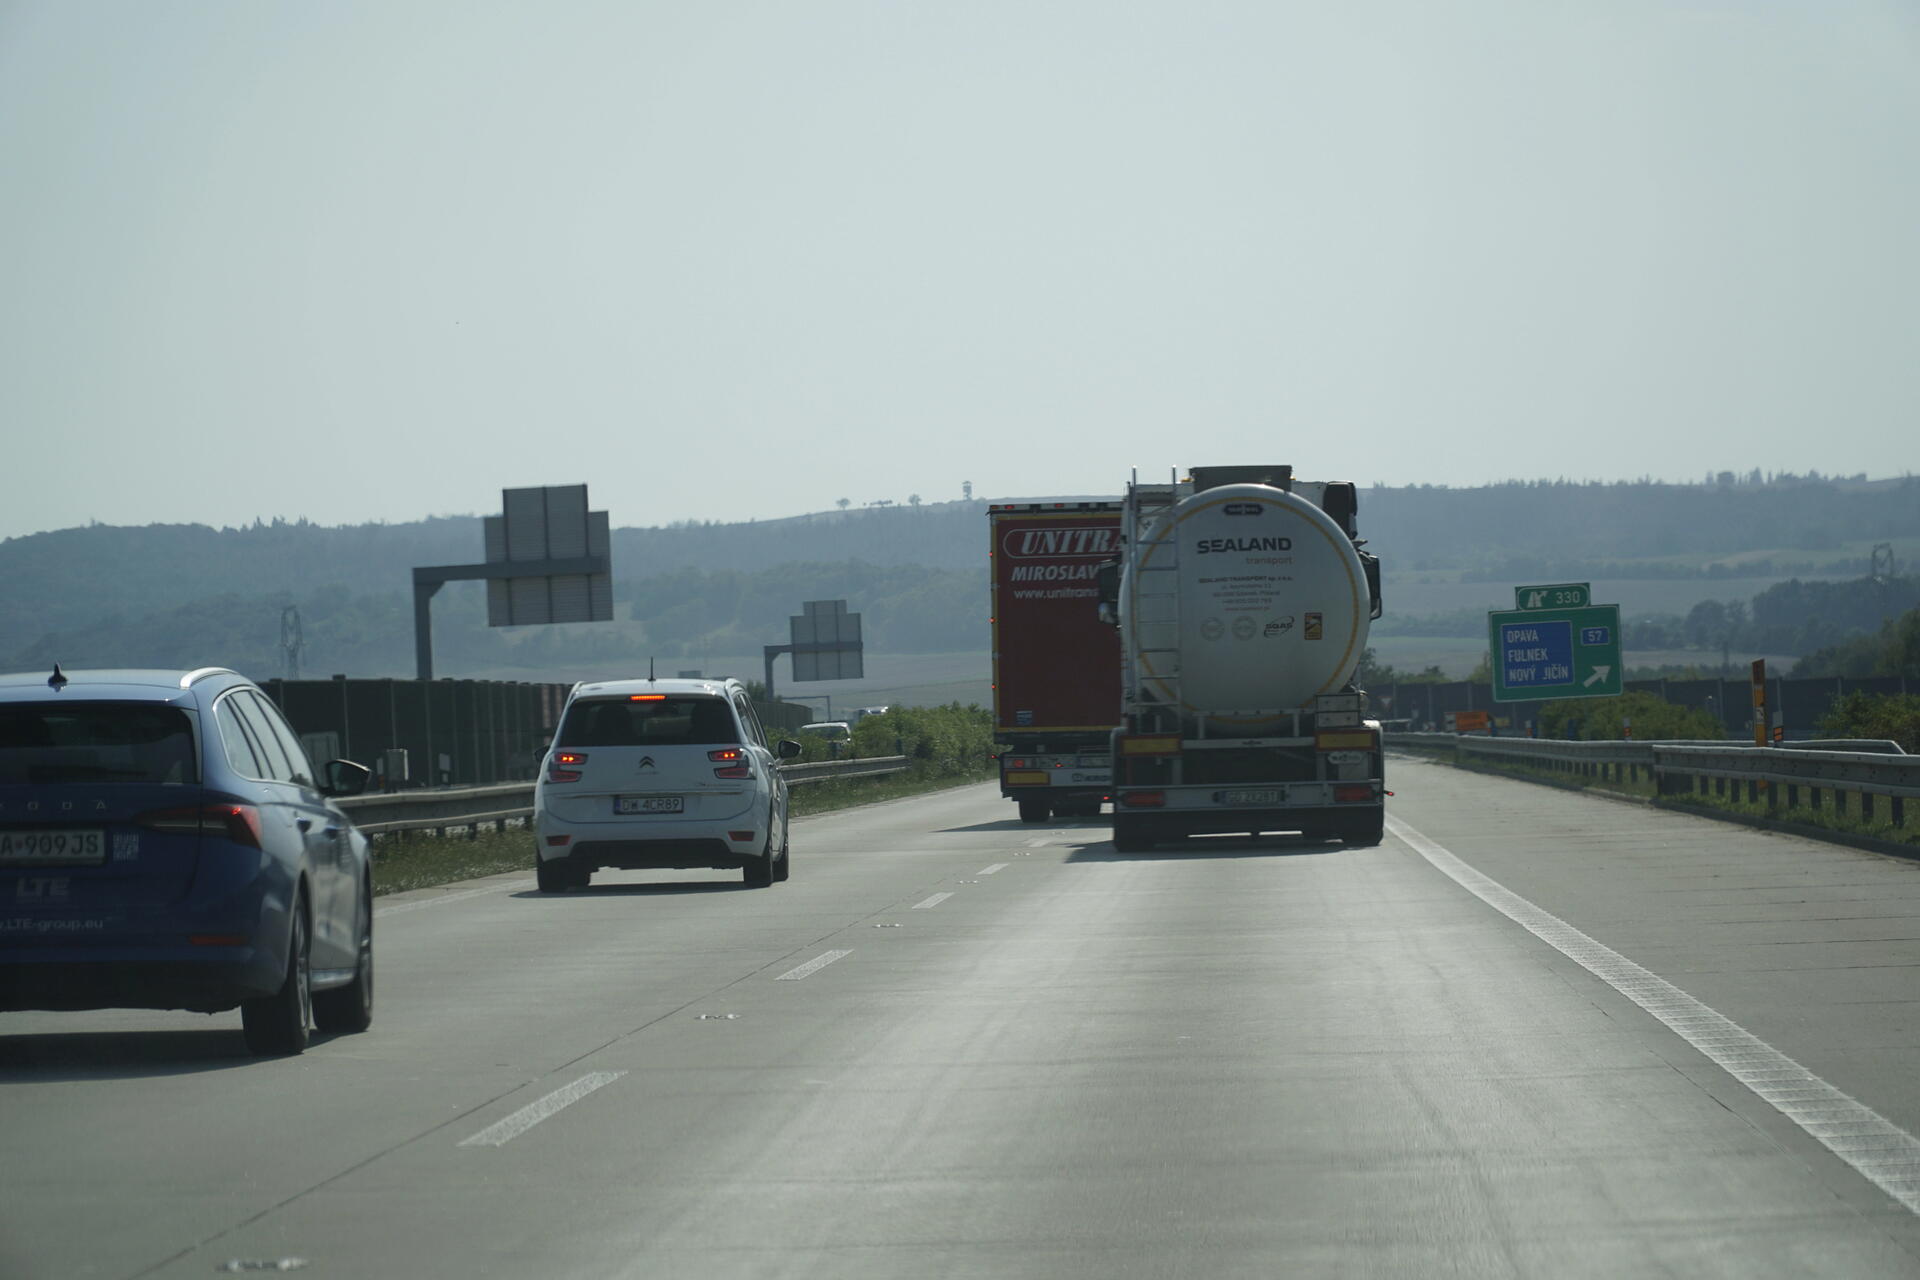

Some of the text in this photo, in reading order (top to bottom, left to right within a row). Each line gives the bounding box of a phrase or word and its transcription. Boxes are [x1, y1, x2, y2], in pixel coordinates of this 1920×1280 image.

[1197, 537, 1292, 554] SEALAND
[1246, 557, 1292, 567] transport
[1010, 565, 1099, 581] MIROSLAV
[1555, 591, 1580, 604] 330
[1507, 629, 1539, 643] OPAVA
[1588, 630, 1602, 642] 57
[1508, 648, 1548, 662] FULNEK
[1509, 664, 1569, 682] NOVÝ JIČÍN
[16, 878, 70, 897] LTE
